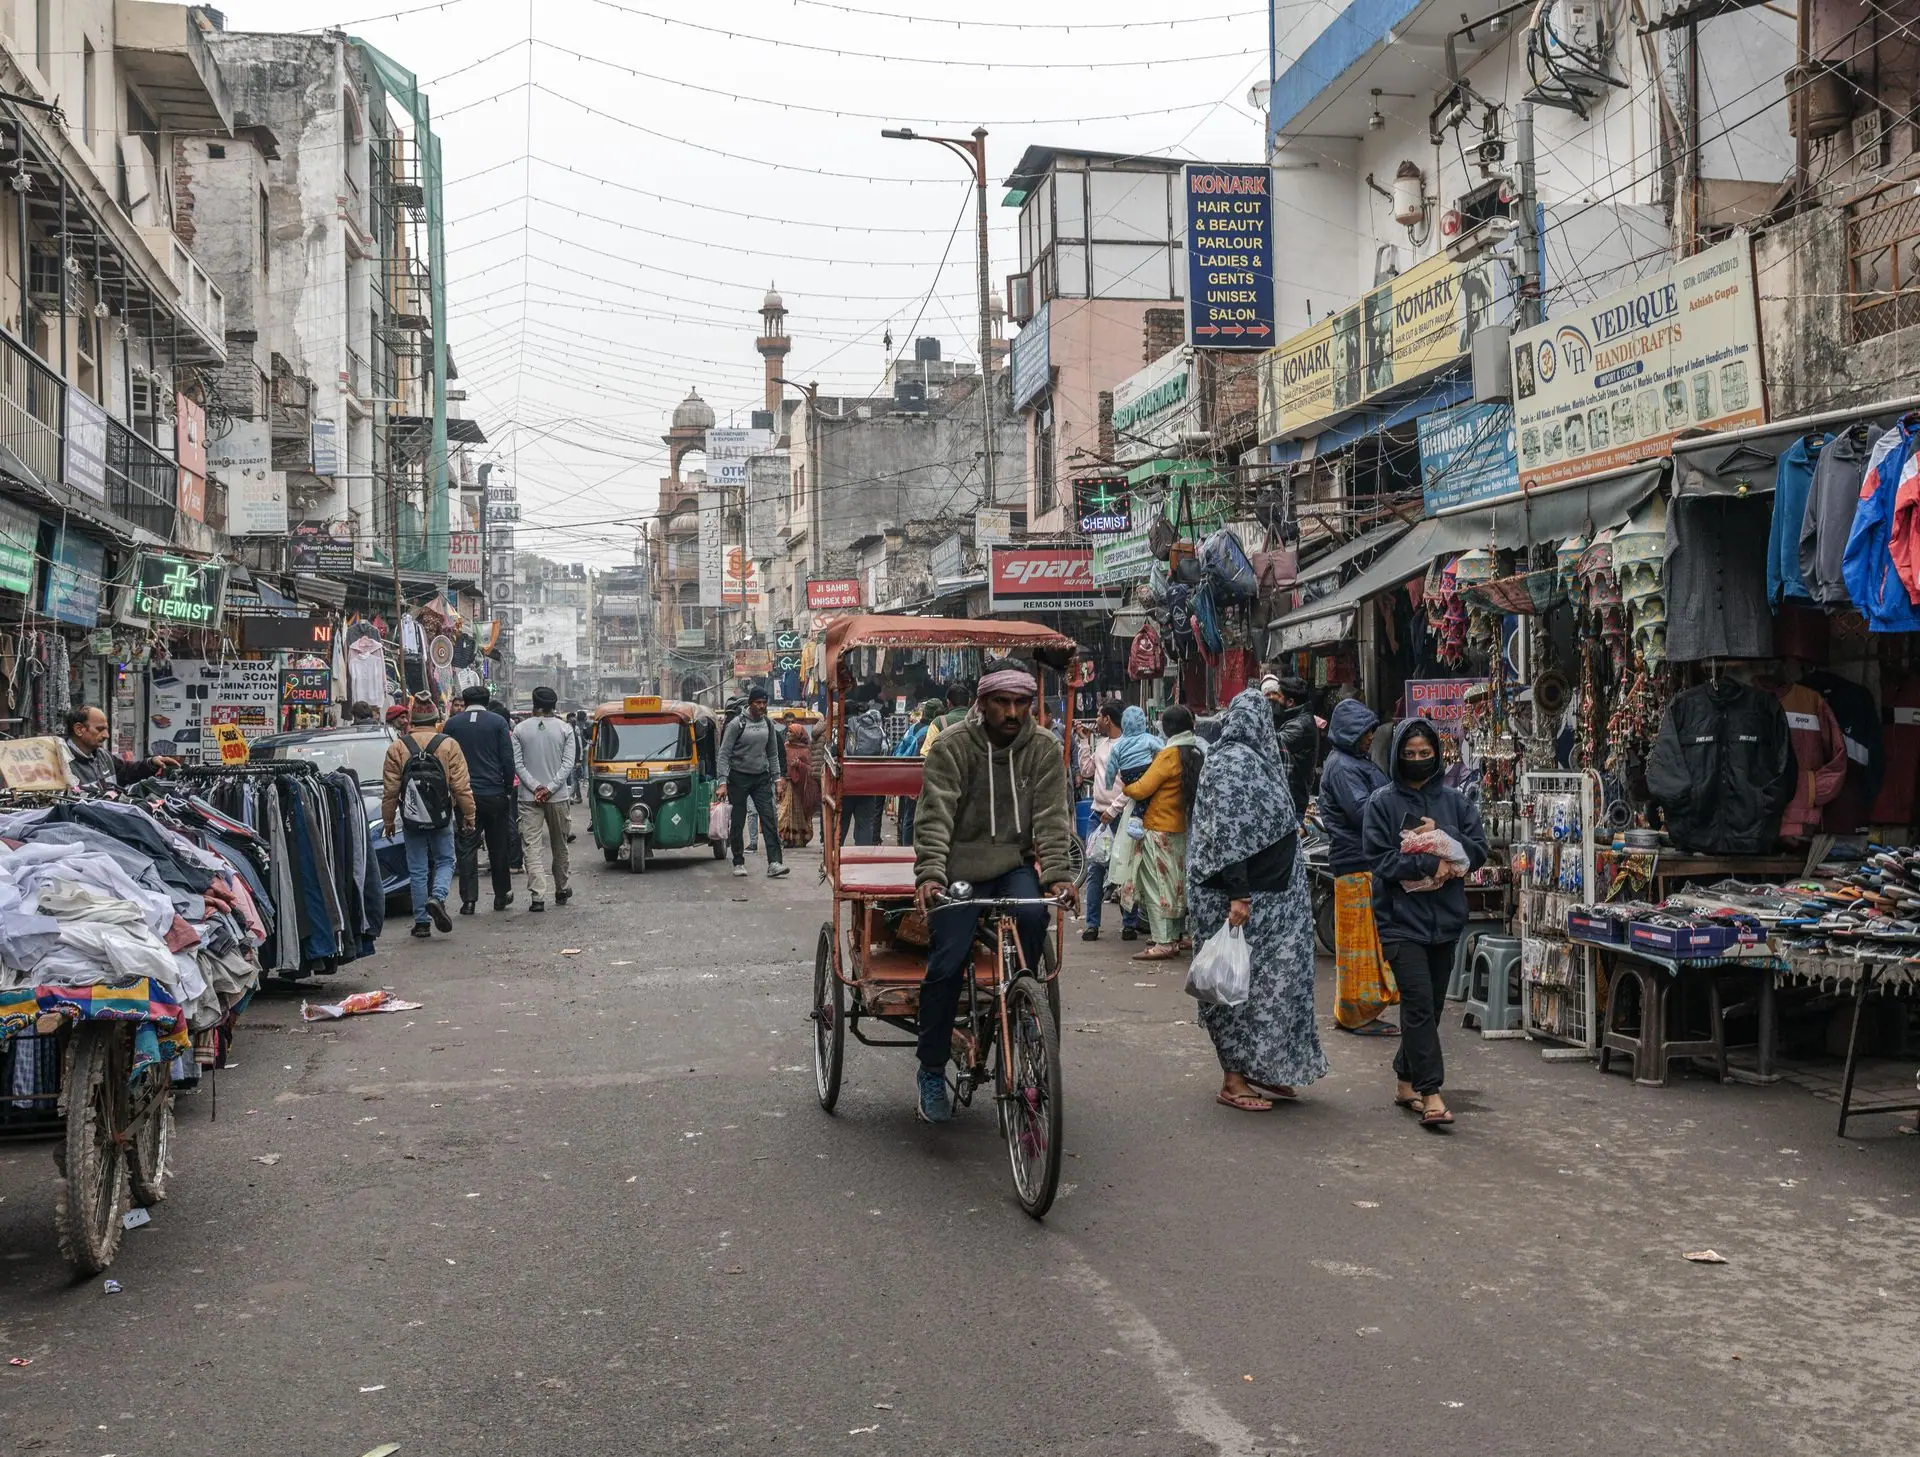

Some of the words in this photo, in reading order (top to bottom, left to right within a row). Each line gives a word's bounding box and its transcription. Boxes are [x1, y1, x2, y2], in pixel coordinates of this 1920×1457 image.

[1191, 175, 1265, 194] KONARK
[1197, 201, 1230, 213] HAIR
[1234, 201, 1261, 213] CUT
[1196, 219, 1205, 230] &
[1209, 220, 1264, 231] BEAUTY
[1198, 237, 1263, 249] PARLOUR
[1200, 255, 1248, 267] LADIES
[1252, 255, 1262, 267] &
[1208, 273, 1254, 284] GENTS
[1207, 291, 1257, 303] UNISEX
[1396, 273, 1453, 328] KONARK
[1689, 293, 1714, 312] Ashish
[1714, 285, 1739, 300] Gupta
[1209, 309, 1256, 320] SALON
[1592, 283, 1678, 342] VEDIQUE
[1595, 323, 1682, 371] HANDICRAFTS
[1283, 340, 1330, 387] KONARK
[1638, 374, 1653, 388] Marble
[1653, 371, 1666, 382] Chess
[1673, 365, 1684, 378] Type
[1685, 359, 1690, 372] of
[1690, 357, 1705, 371] Indian
[1705, 346, 1733, 365] Handicrafts
[1734, 343, 1749, 356] Items
[1135, 373, 1187, 422] PHARMACY
[1422, 422, 1473, 458] DHINGRA
[487, 489, 514, 501] HOTEL
[1082, 515, 1127, 530] CHEMIST
[448, 535, 478, 554] BTI
[816, 585, 824, 593] JI
[825, 584, 849, 592] SAHIB
[811, 597, 840, 605] UNISEX
[842, 595, 856, 604] SPA
[1023, 601, 1062, 609] REMSON
[1064, 600, 1094, 608] SHOES
[232, 662, 274, 671] XEROX
[242, 673, 277, 681] SCAN
[303, 675, 322, 686] ICE
[210, 682, 278, 690] LAMINATION
[218, 693, 249, 701] PRINT
[252, 693, 274, 701] OUT
[291, 689, 327, 700] CREAM
[9, 747, 44, 762] SALE
